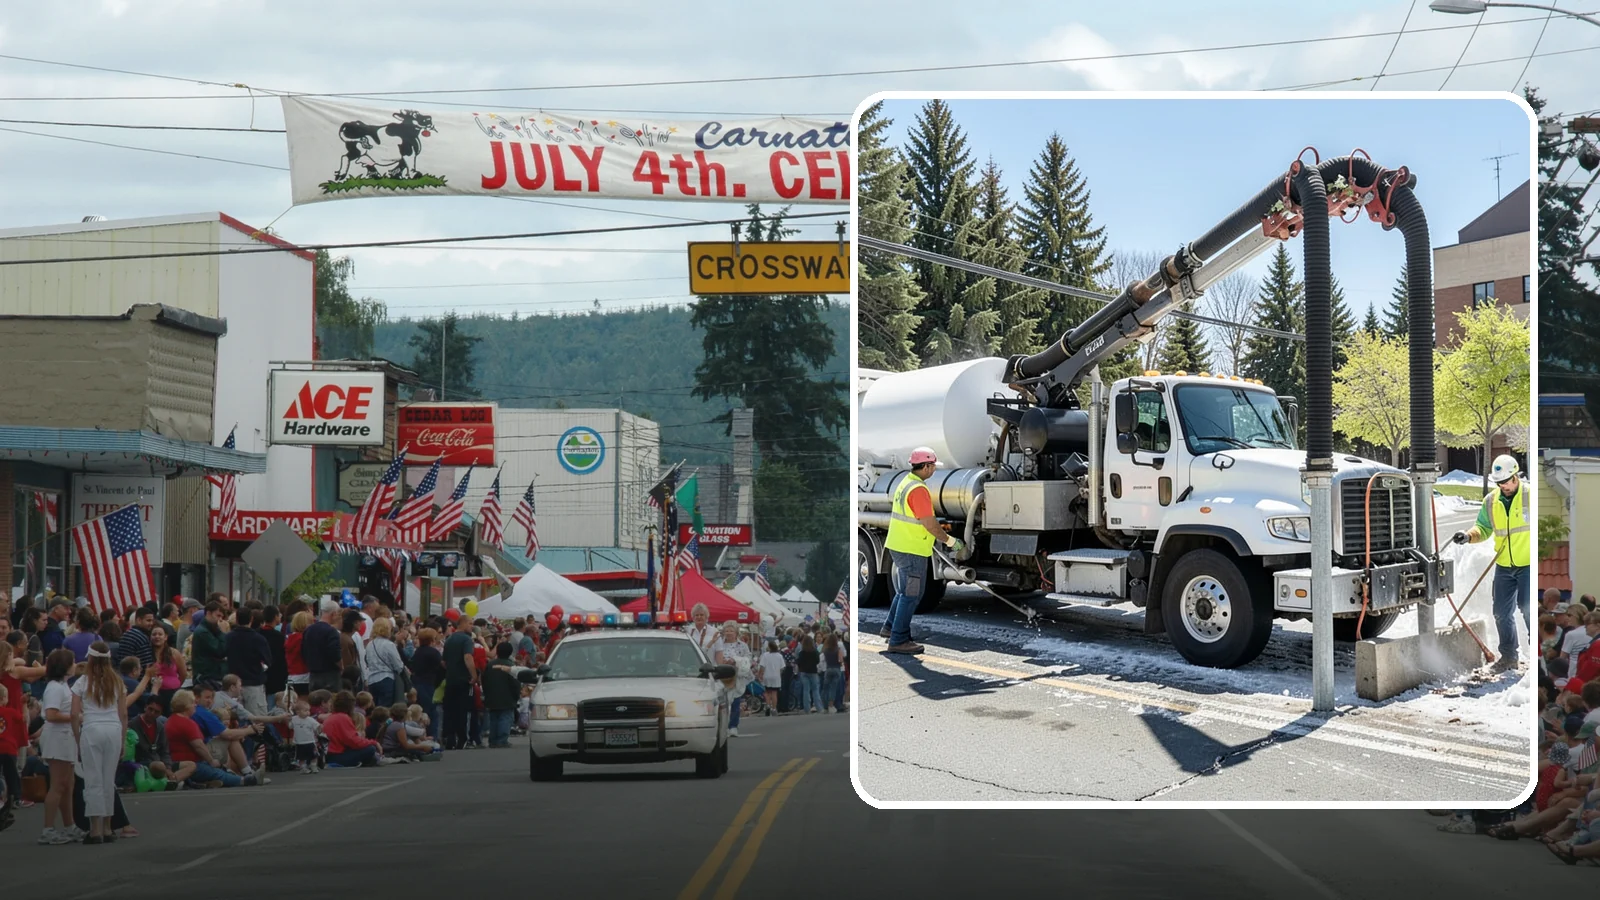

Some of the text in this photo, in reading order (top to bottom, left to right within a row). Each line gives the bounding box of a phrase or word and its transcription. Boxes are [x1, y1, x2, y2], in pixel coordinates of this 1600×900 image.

[481, 141, 605, 192] JULY
[632, 150, 746, 198] 4th.
[696, 254, 850, 280] CROSSWA
[282, 380, 374, 420] ACE
[405, 409, 485, 422] CEDAR LOG
[283, 421, 371, 436] Hardware
[416, 428, 477, 447] Coca-Cola
[353, 467, 385, 479] Simpl
[95, 485, 125, 495] Vincent
[126, 486, 136, 495] de
[137, 486, 155, 495] Paul
[688, 526, 741, 535] CRNATION
[699, 535, 730, 544] GLASS
